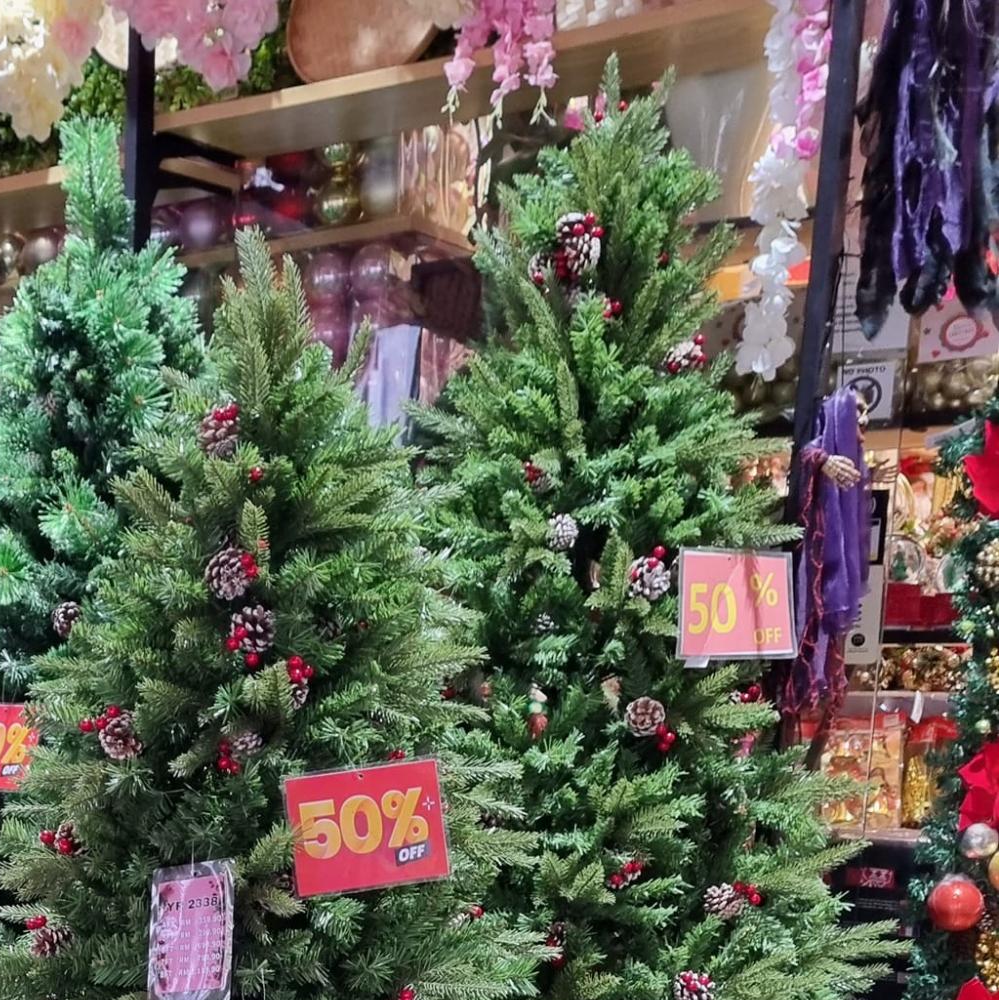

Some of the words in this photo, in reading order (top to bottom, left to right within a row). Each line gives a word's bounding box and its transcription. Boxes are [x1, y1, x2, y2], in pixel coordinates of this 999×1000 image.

[753, 627, 782, 645] OFF
[1, 764, 20, 776] OFF
[298, 786, 429, 860] 50%
[398, 844, 426, 863] OFF
[188, 896, 218, 910] 2338
